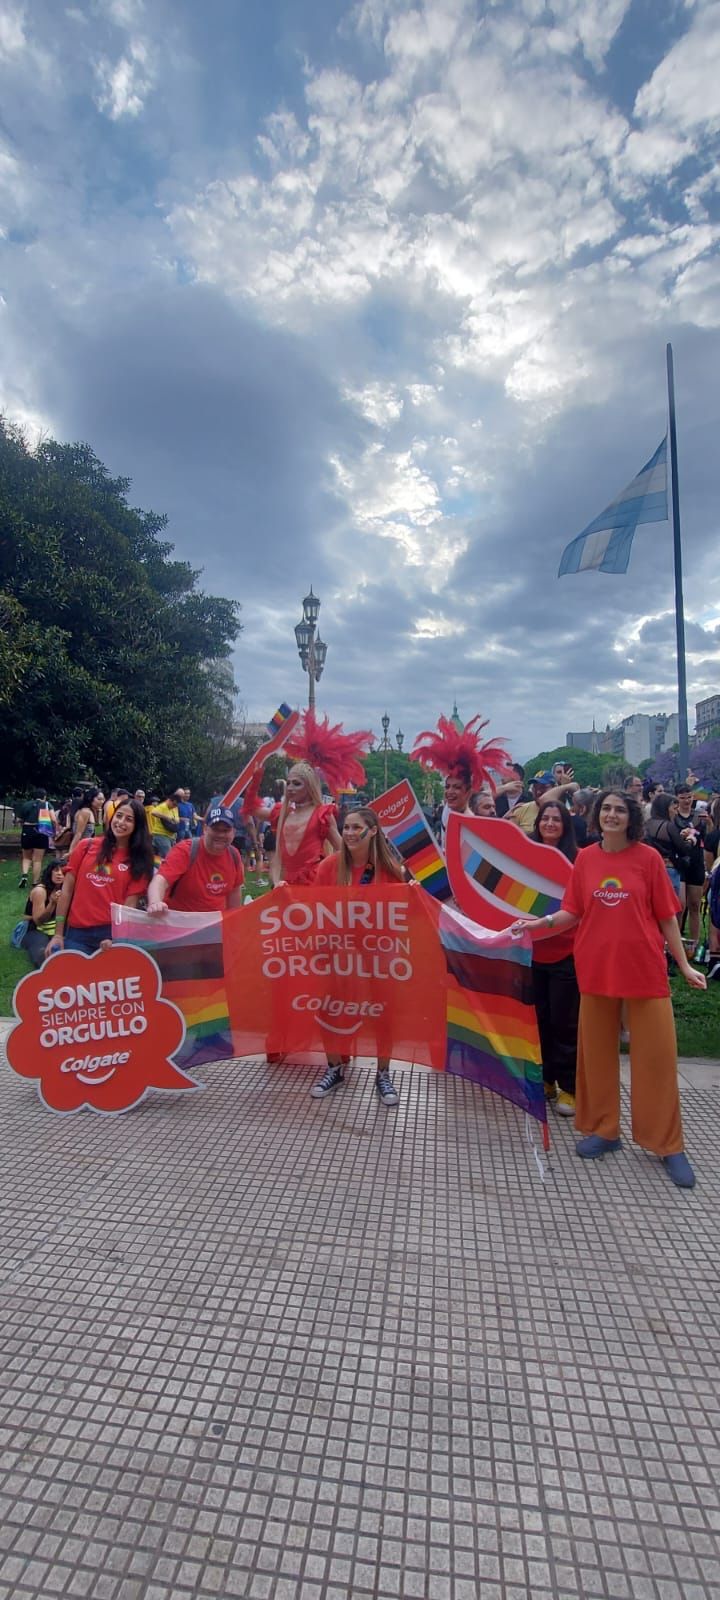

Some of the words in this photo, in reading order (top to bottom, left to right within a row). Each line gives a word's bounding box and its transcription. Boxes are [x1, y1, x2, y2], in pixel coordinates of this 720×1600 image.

[378, 795, 409, 818] Colgate
[593, 890, 629, 899] Colgate
[259, 901, 409, 935] SONRIE
[262, 934, 356, 955] SIEMPRE
[362, 934, 410, 955] CON
[262, 953, 413, 981] ORGULLO
[37, 976, 142, 1012] SONRIE
[291, 994, 384, 1017] Colgate
[41, 1006, 107, 1027] SIEMPRE
[111, 1001, 145, 1017] CON
[40, 1015, 148, 1048] ORGULLO
[60, 1051, 130, 1073] Colgate
